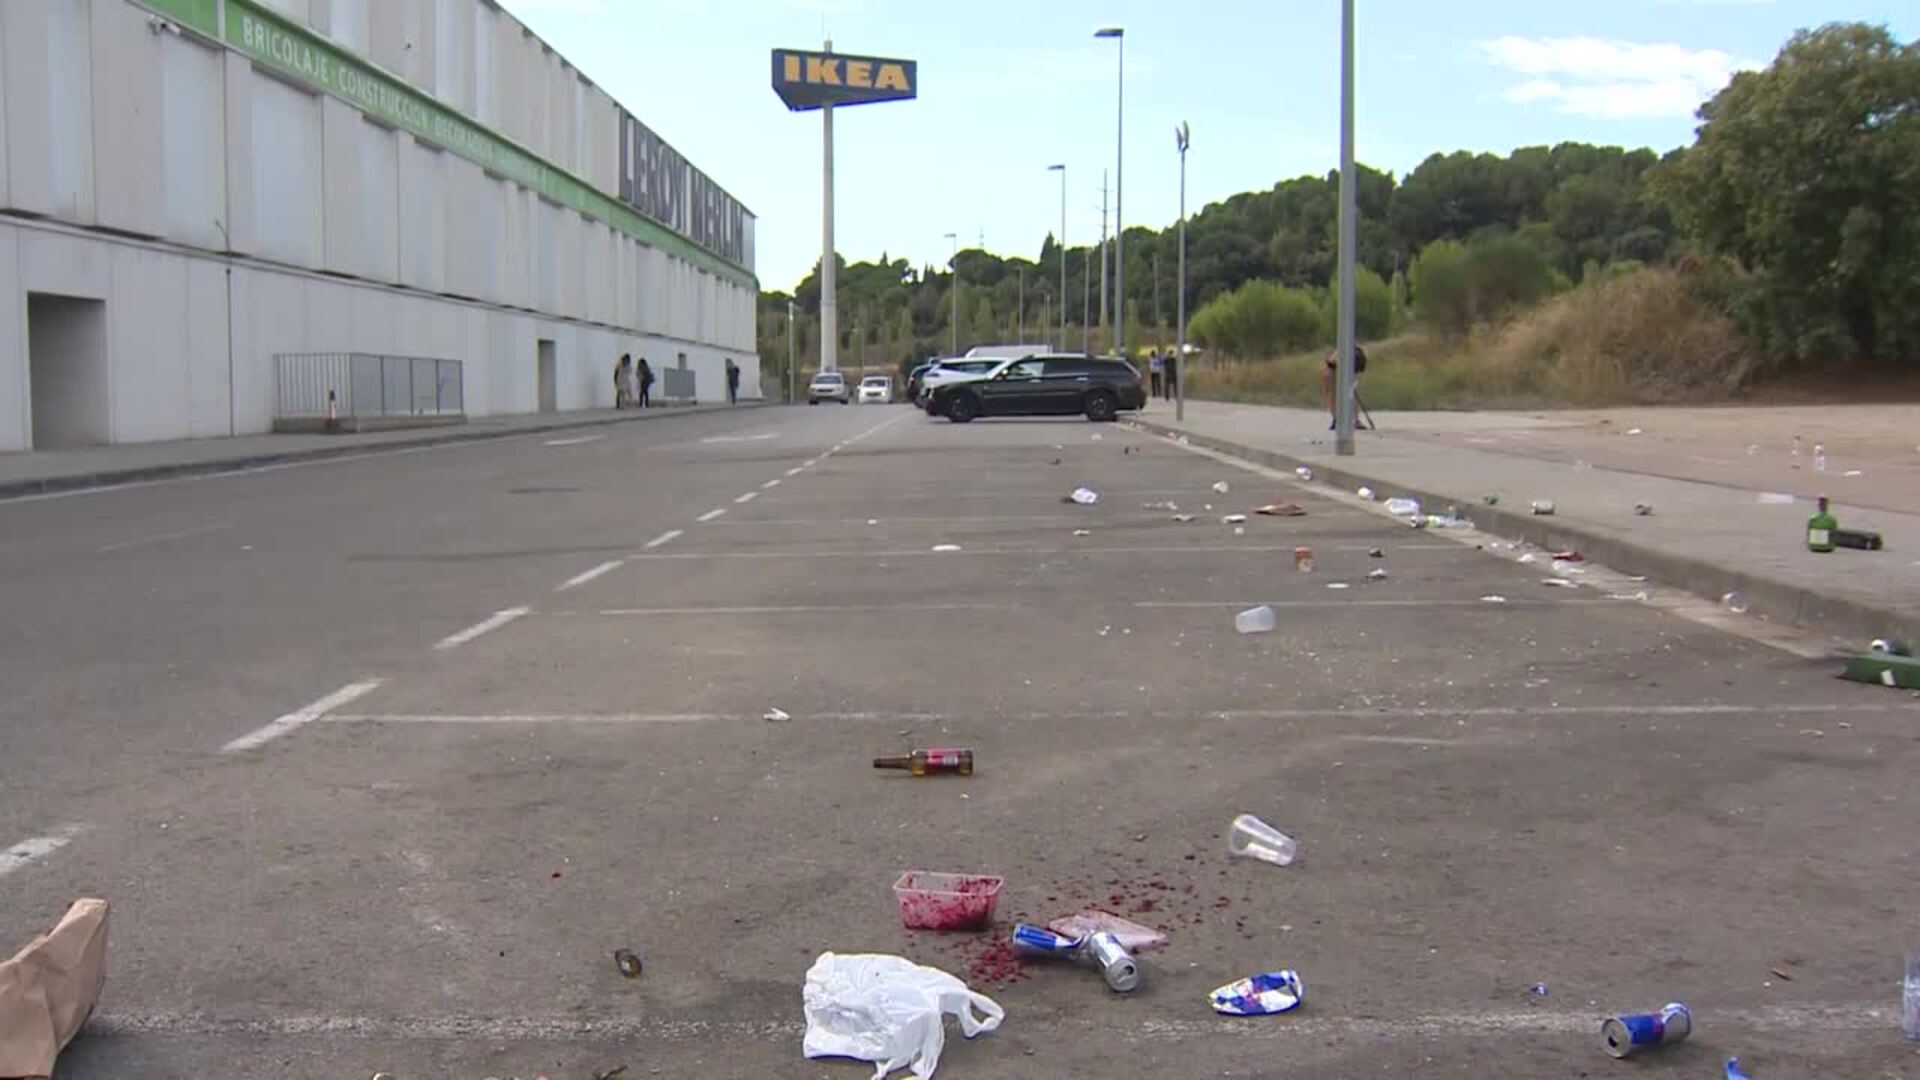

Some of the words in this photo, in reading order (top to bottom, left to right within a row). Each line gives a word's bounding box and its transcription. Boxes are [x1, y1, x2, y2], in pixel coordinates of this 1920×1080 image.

[242, 17, 329, 83] BRICOLAJE
[338, 66, 429, 130] CONSTRUCCION
[784, 54, 910, 91] IKEA
[620, 108, 687, 232] LEROY
[691, 168, 743, 264] MERLIN
